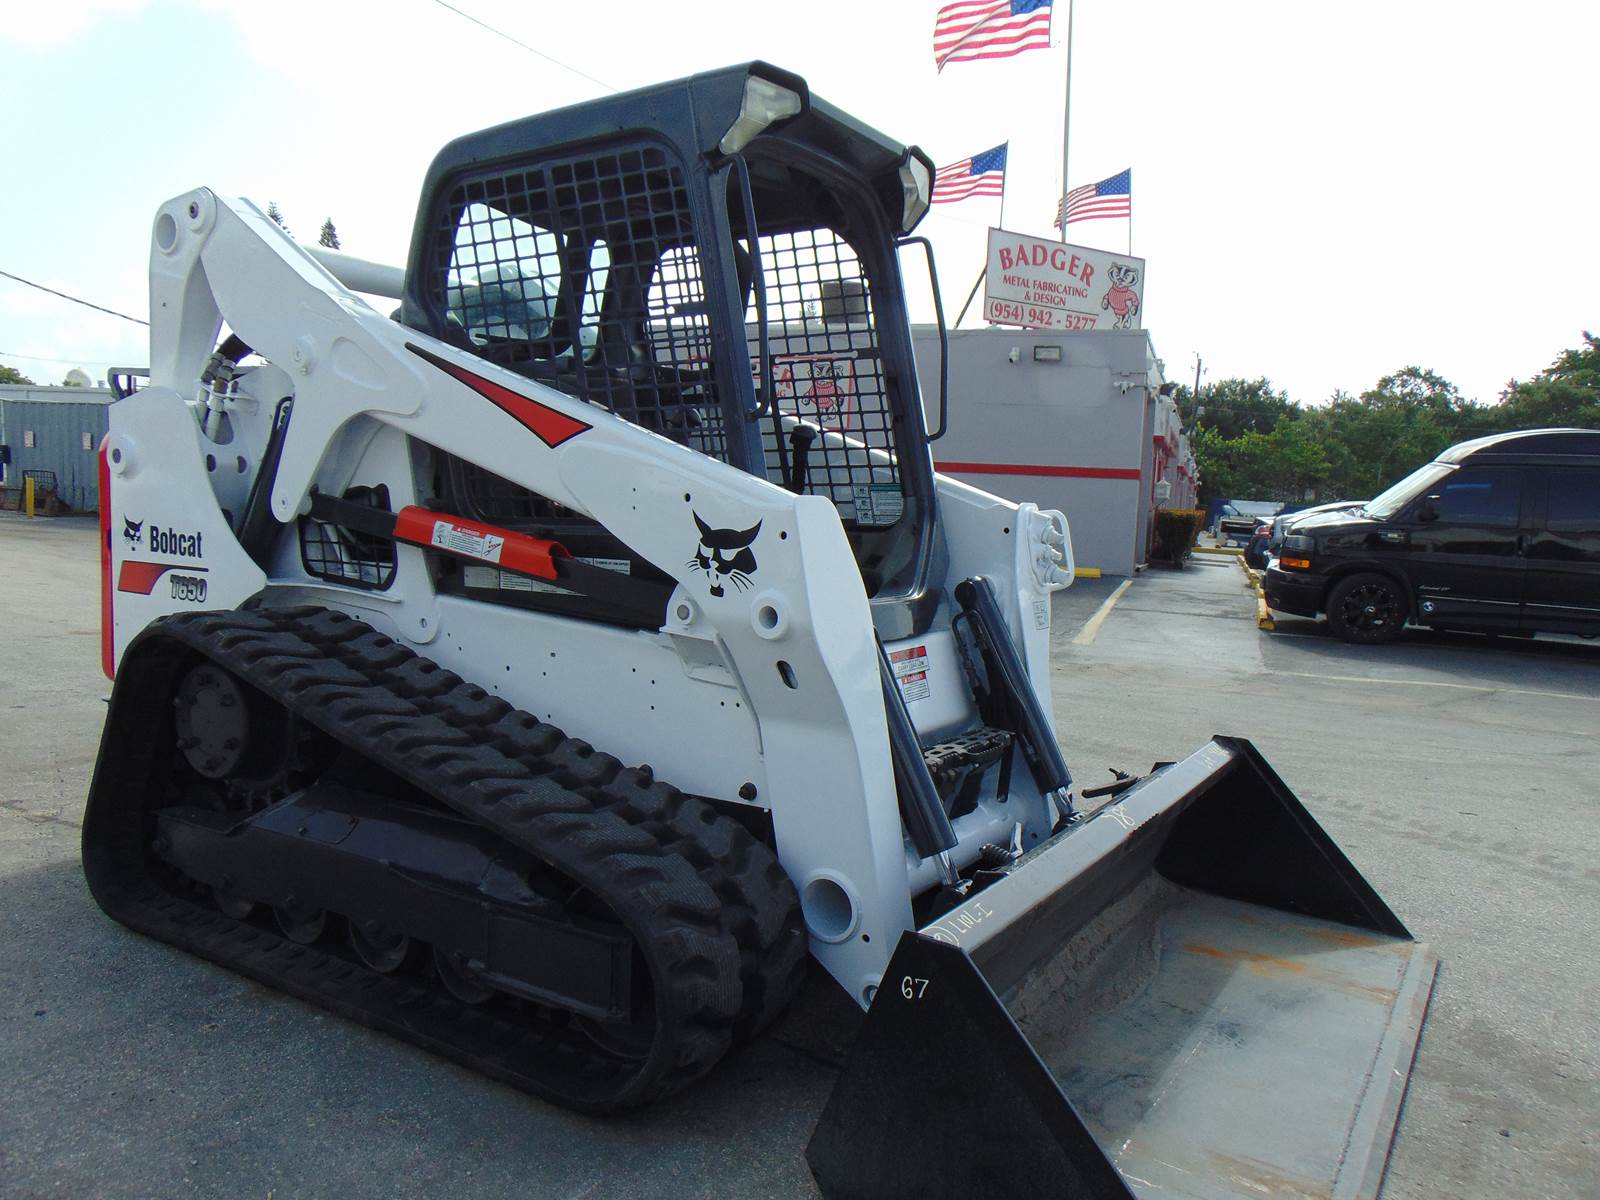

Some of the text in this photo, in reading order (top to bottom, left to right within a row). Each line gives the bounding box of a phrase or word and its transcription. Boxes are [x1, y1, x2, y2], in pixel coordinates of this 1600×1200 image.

[999, 244, 1095, 288] BADGER
[1002, 274, 1088, 298] METAL FABRICATING
[1024, 291, 1067, 307] & DESIGN
[990, 300, 1024, 321] (954)
[1028, 308, 1053, 326] 942
[1065, 314, 1097, 330] 5277
[150, 525, 202, 558] Bobcat
[170, 574, 208, 603] T650
[901, 975, 930, 999] 67
